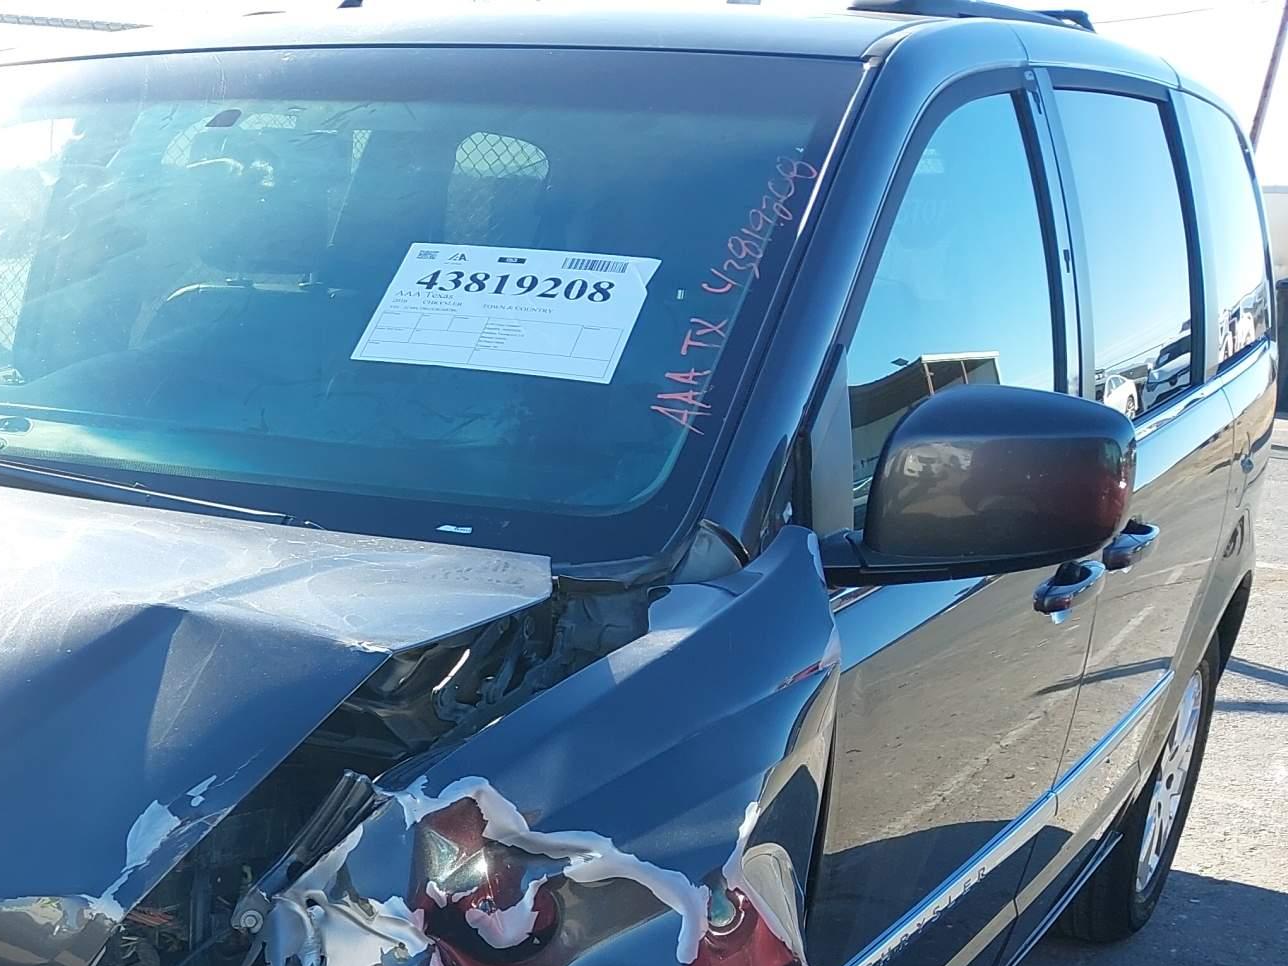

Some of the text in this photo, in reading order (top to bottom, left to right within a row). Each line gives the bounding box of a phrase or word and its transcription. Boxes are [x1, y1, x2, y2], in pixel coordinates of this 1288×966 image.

[415, 269, 617, 303] 43819208
[425, 291, 455, 300] Texas
[650, 368, 712, 436] AAA
[681, 317, 729, 356] TX
